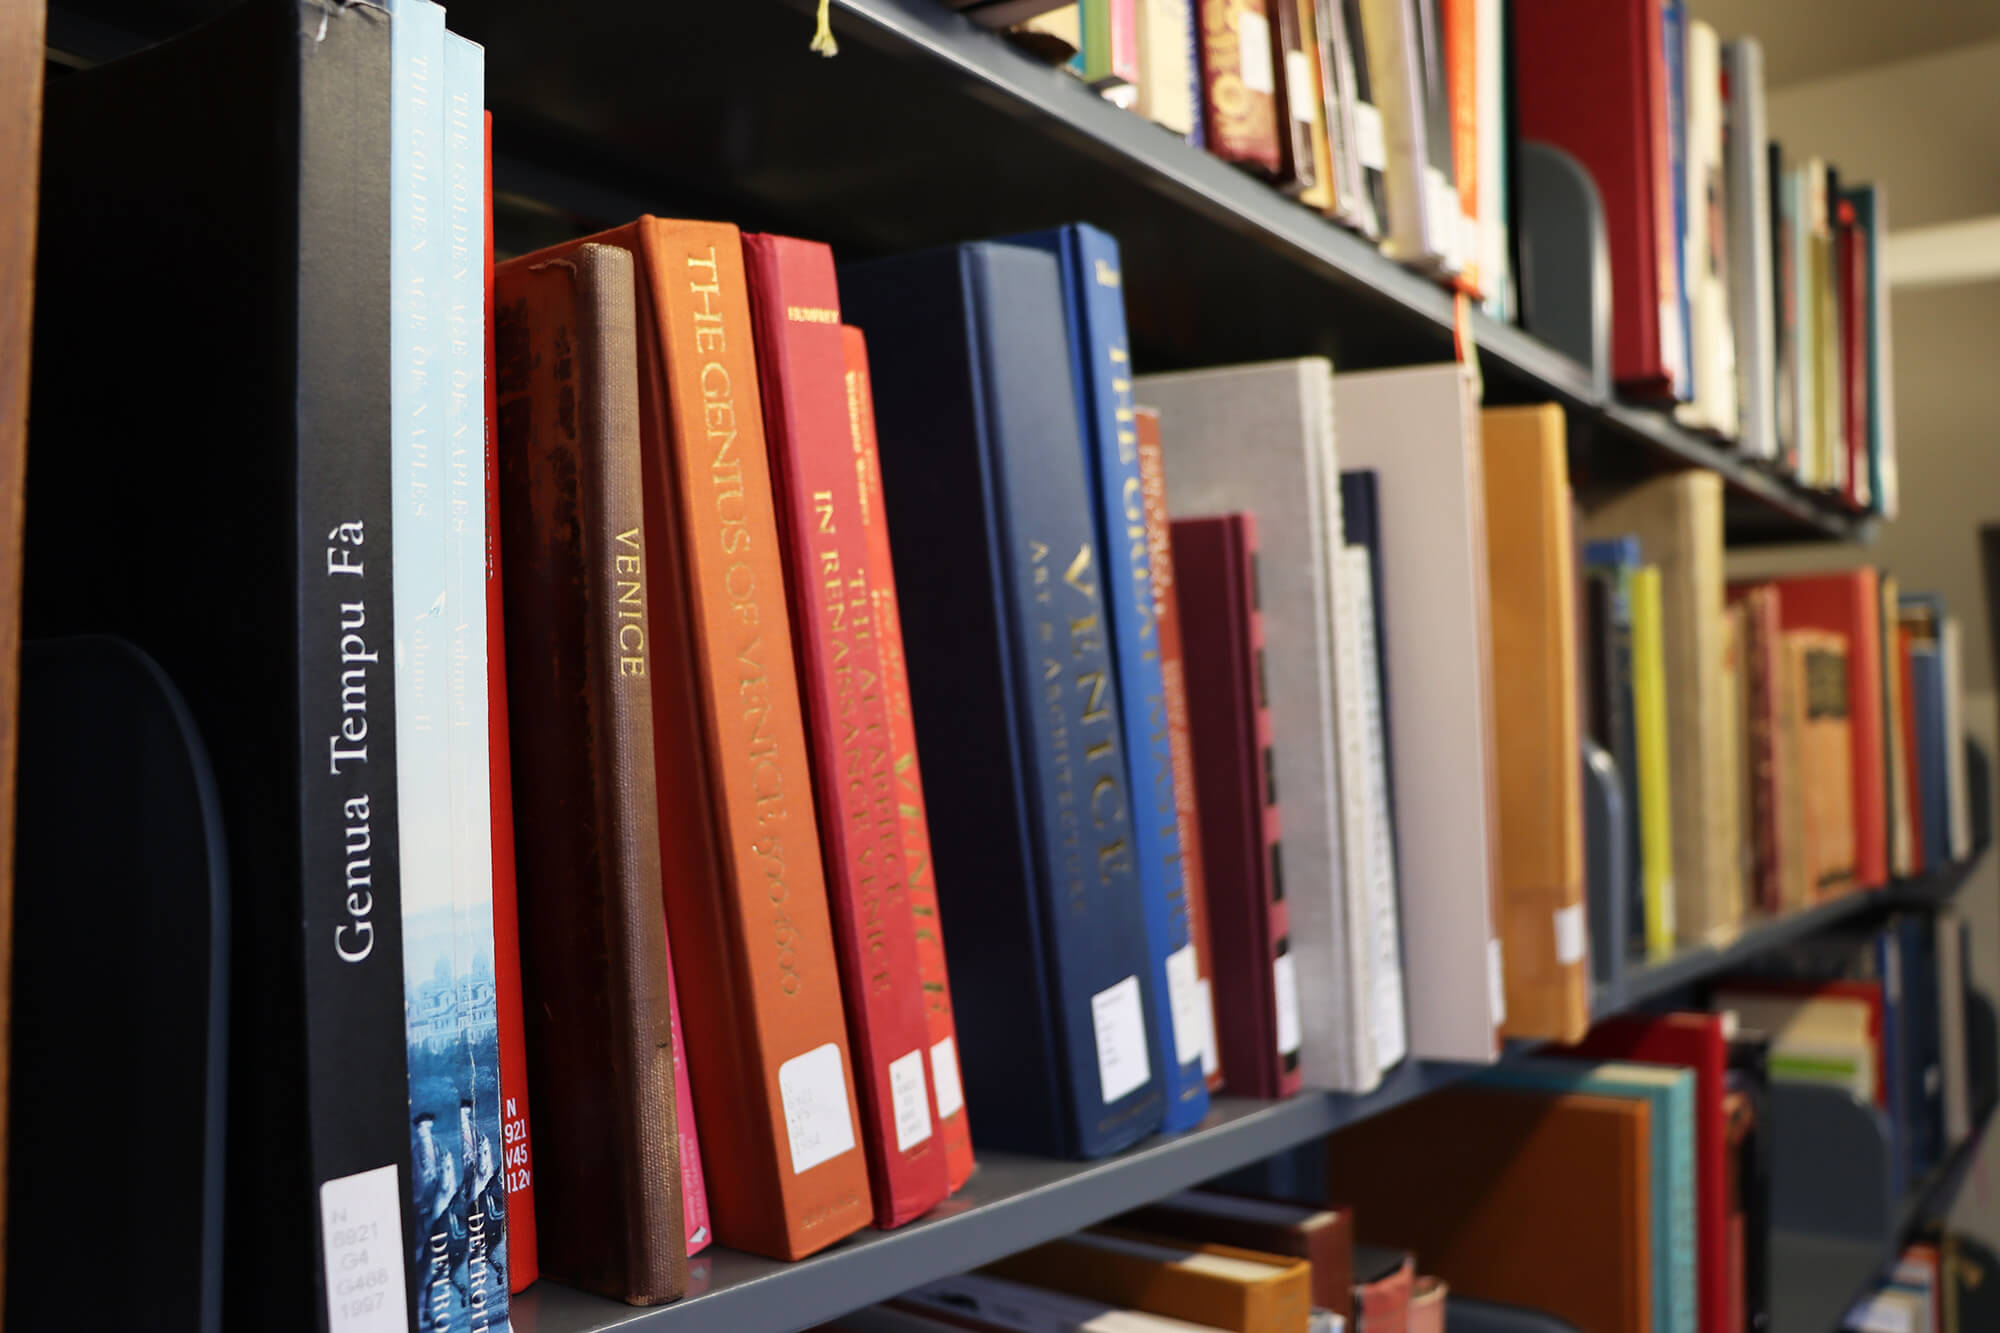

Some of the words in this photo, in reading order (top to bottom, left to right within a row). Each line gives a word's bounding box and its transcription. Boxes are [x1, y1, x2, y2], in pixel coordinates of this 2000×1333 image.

[411, 55, 428, 115] THE
[453, 91, 469, 151] THE
[411, 128, 428, 255] GOLDEN
[453, 162, 469, 282] GOLDEN
[687, 245, 726, 354] THE
[411, 402, 430, 518] NAPLES
[452, 424, 470, 533] NAPLES
[700, 361, 751, 555] GENIUS
[813, 490, 837, 534] IN
[326, 519, 365, 579] Fà
[615, 528, 645, 676] VENICE
[725, 560, 760, 626] OF
[848, 567, 872, 648] THE
[329, 600, 379, 775] Tempu
[737, 636, 788, 826] VENICE
[821, 549, 872, 833] RENAISSANCE
[1063, 543, 1132, 886] VENICE
[334, 793, 375, 964] Genua
[858, 847, 892, 996] VENICE
[504, 1119, 527, 1144] 921
[506, 1098, 516, 1118] N
